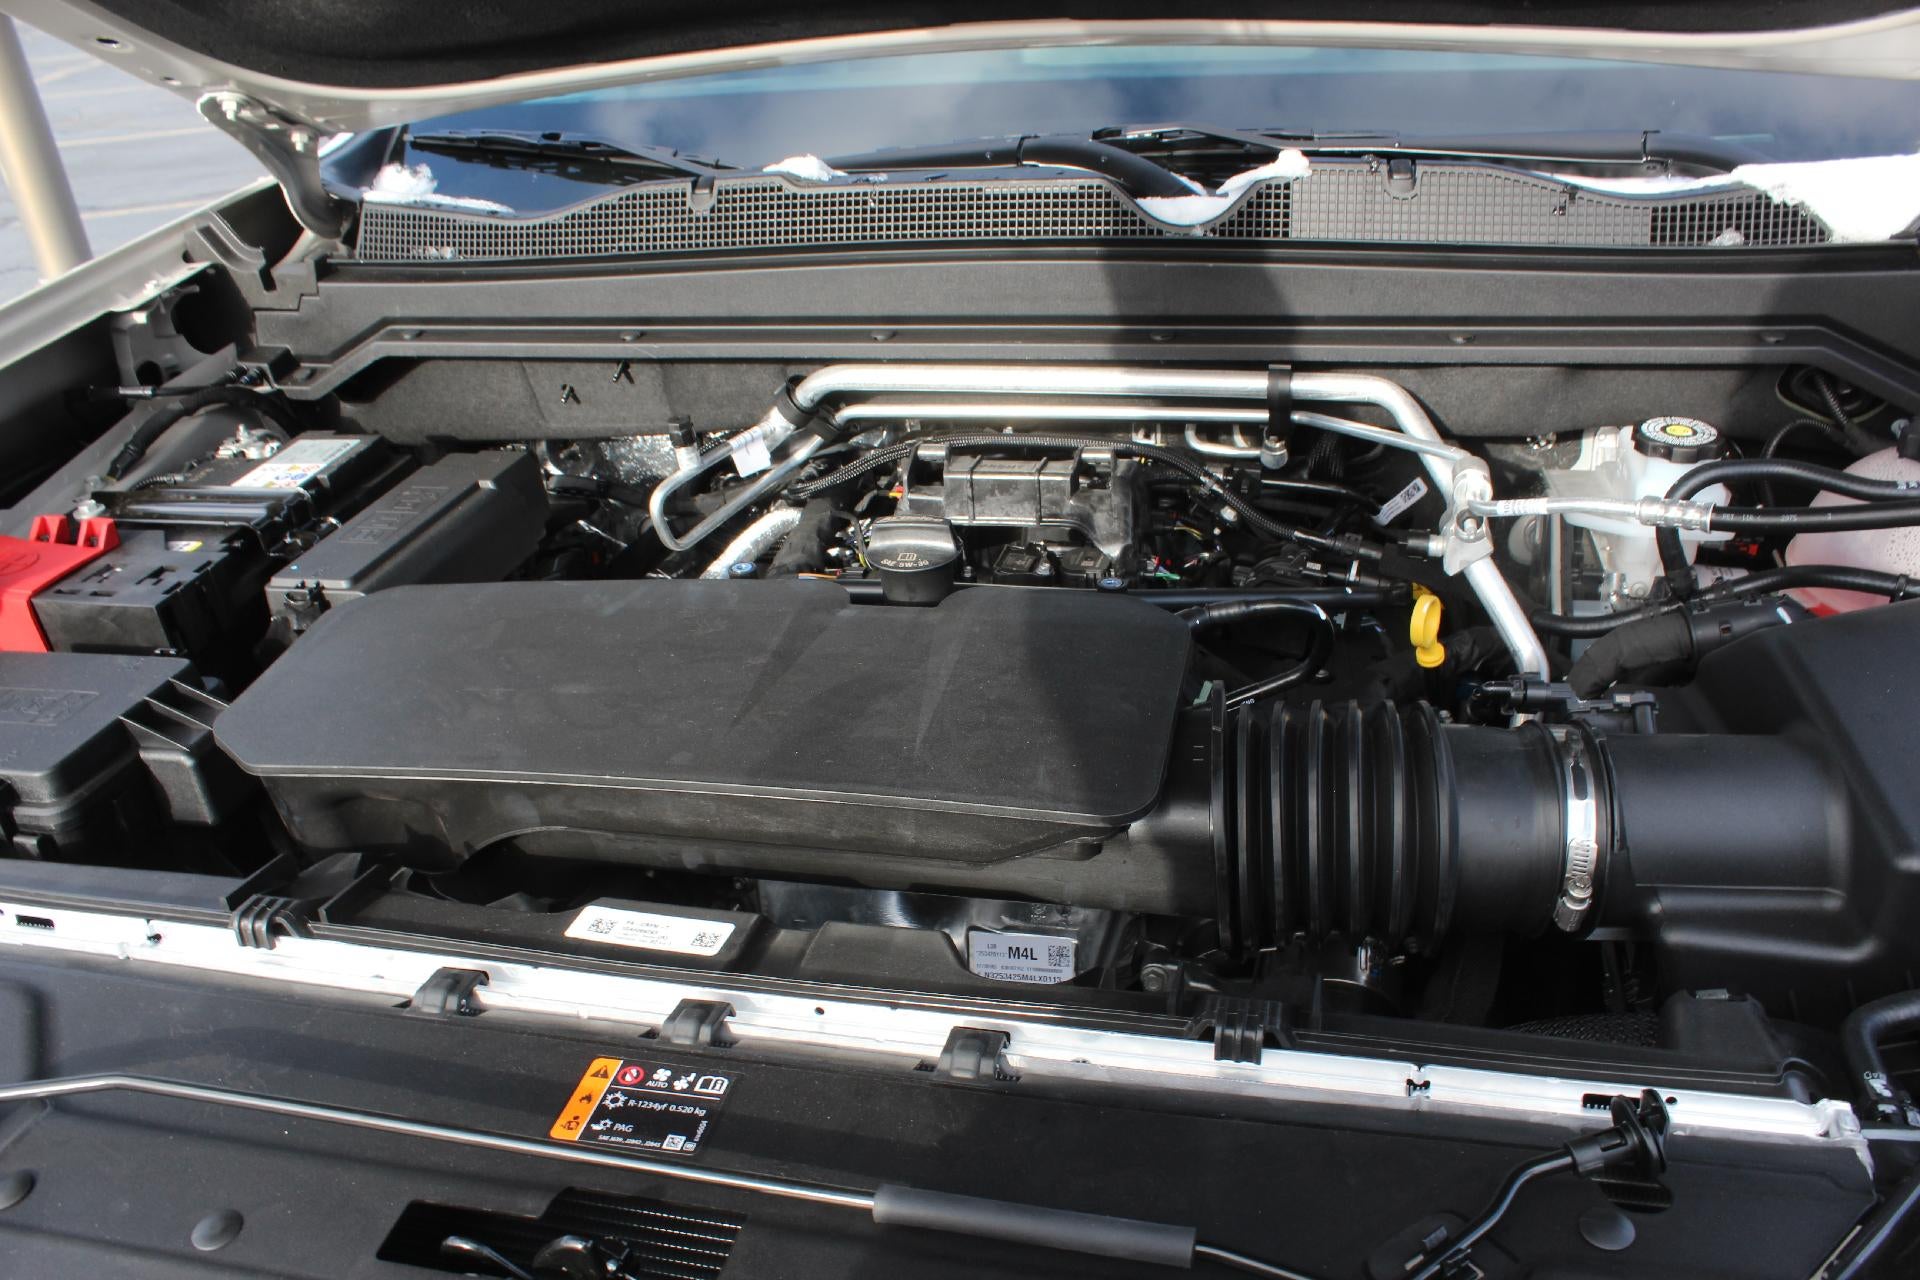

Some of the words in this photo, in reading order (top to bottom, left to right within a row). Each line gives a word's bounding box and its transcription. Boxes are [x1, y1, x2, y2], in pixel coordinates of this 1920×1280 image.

[1008, 946, 1038, 961] M4L
[645, 1080, 668, 1088] AUTO
[628, 1100, 668, 1111] R-1234yf
[669, 1104, 694, 1114] 0.520
[694, 1106, 707, 1117] kg
[613, 1123, 634, 1132] PAG
